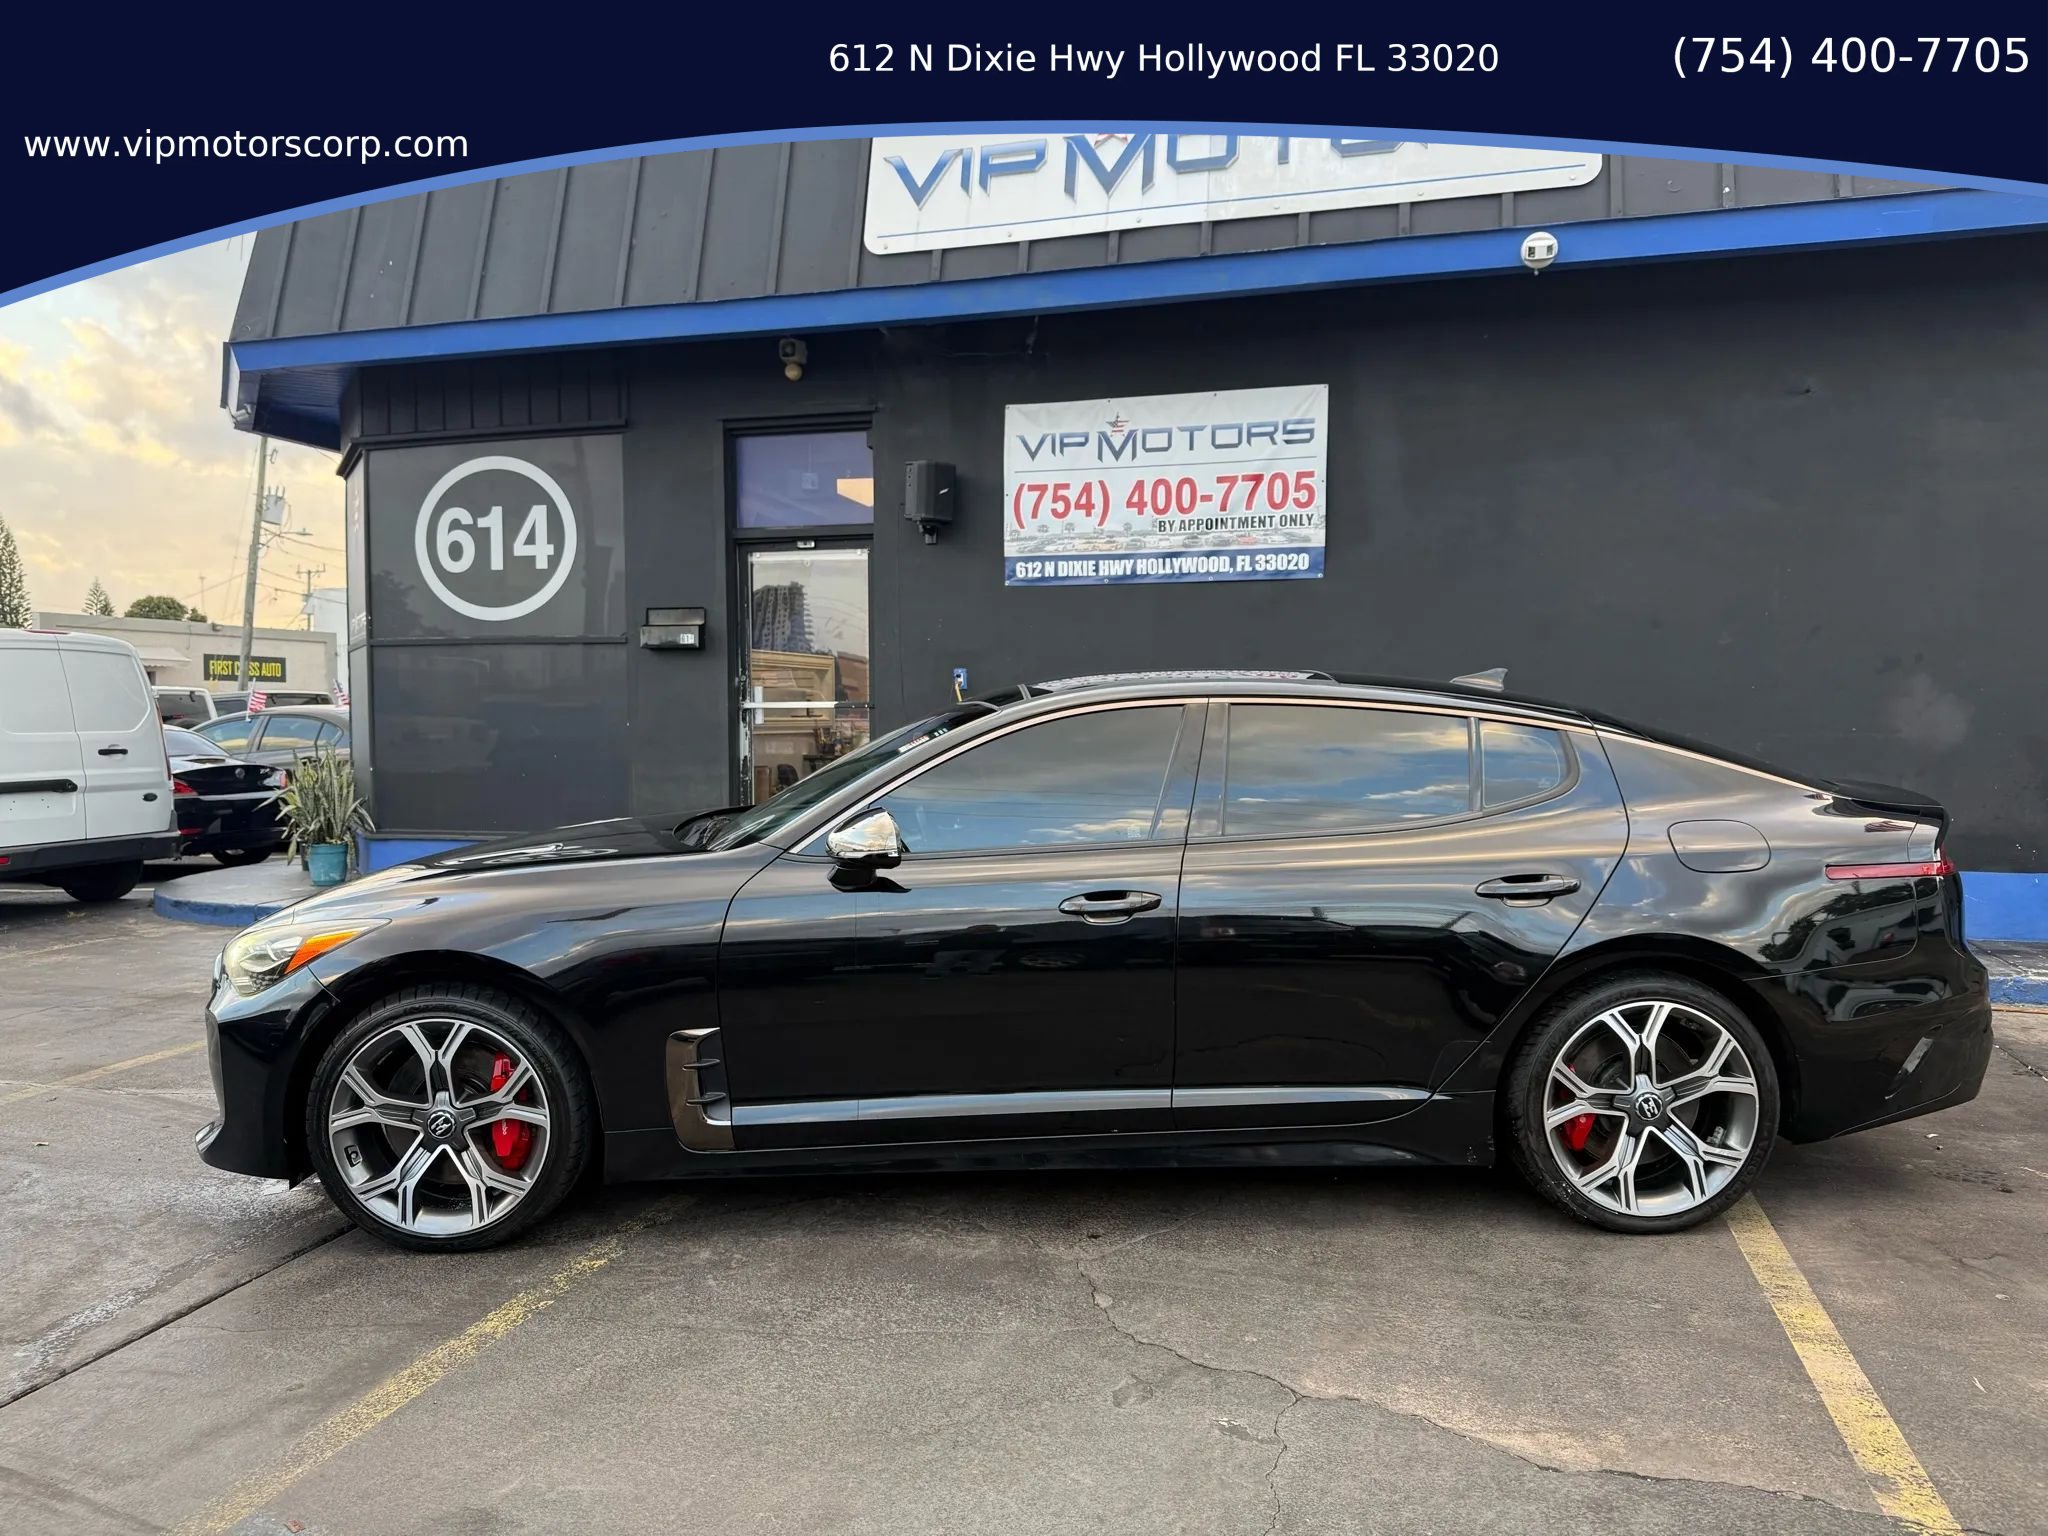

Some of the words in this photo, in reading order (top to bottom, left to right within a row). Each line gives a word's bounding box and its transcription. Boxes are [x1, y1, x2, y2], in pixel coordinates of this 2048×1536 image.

[884, 138, 1048, 211] VIP
[1016, 431, 1089, 462] VIP
[1096, 418, 1315, 463] MOTORS
[1013, 480, 1110, 529] (754)
[1126, 470, 1315, 516] 400-7705
[437, 505, 554, 573] 614
[1158, 520, 1175, 532] BY
[1179, 515, 1275, 531] APPOINTMENT
[1279, 514, 1314, 528] ONLY
[1016, 561, 1042, 578] 612
[1045, 561, 1055, 577] N
[1058, 560, 1096, 577] DIXIE
[1099, 559, 1134, 576] HWY
[1136, 555, 1233, 575] HOLLYWOOD,
[1236, 555, 1252, 572] FL
[1255, 553, 1309, 571] 33020
[209, 660, 233, 675] FIRST
[234, 660, 260, 676] CSS
[261, 662, 282, 677] AUTO
